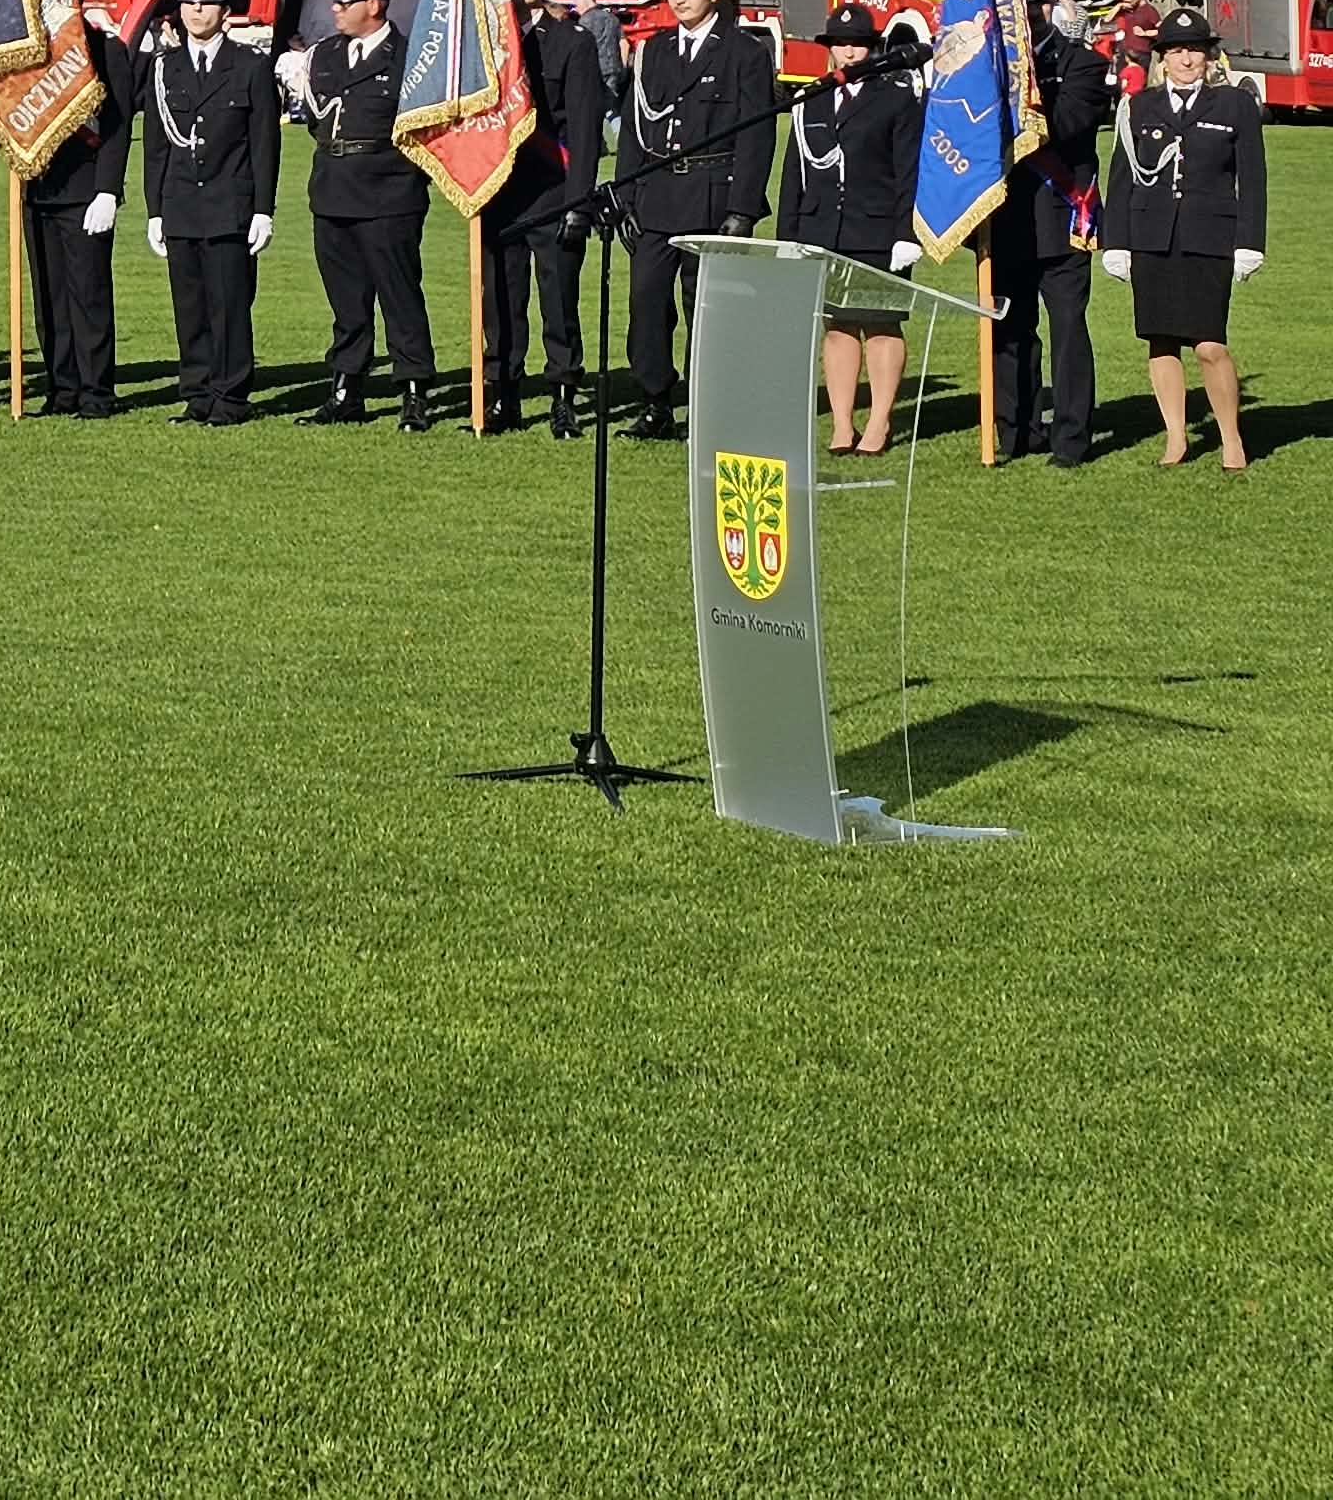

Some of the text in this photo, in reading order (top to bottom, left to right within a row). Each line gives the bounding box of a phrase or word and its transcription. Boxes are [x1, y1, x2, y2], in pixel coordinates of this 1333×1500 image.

[7, 43, 90, 133] OJCZYZNY
[929, 129, 971, 176] 2009
[711, 606, 807, 641] Gmina Komorniki
